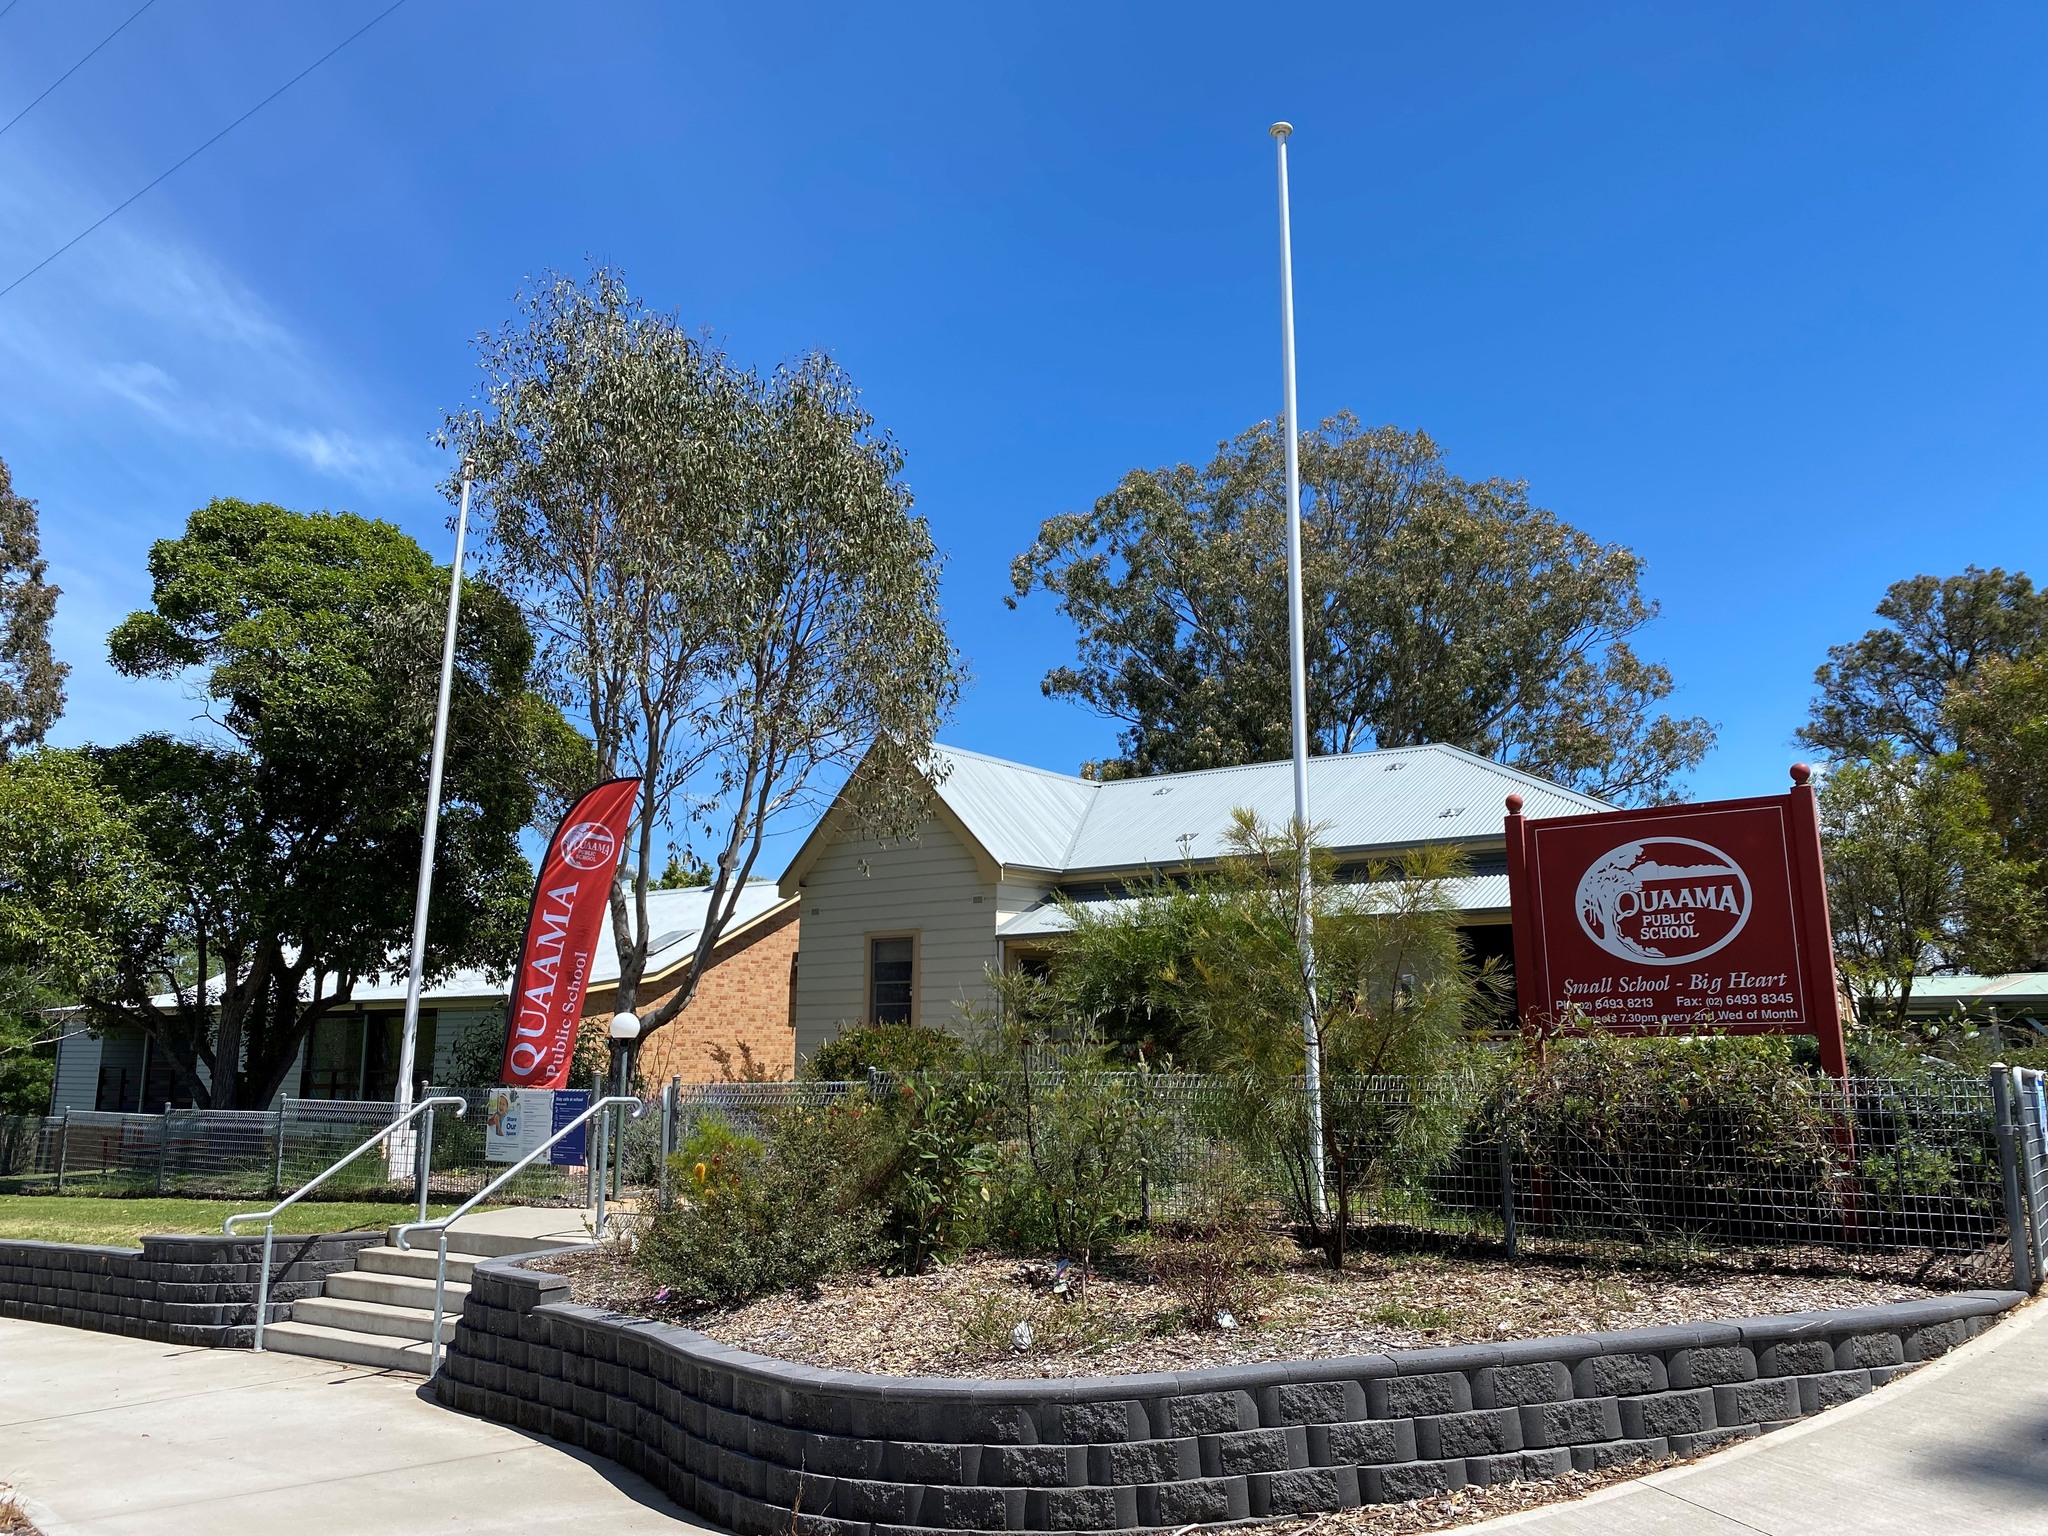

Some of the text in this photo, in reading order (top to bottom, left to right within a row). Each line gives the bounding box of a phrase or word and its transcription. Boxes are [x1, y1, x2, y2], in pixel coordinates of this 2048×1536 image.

[1614, 885, 1741, 922] QUAAMA
[1642, 912, 1695, 927] PUBLIC
[1640, 925, 1700, 940] SCHOOL
[510, 881, 580, 1077] QUAAMA
[1563, 977, 1613, 997] Small
[1618, 974, 1671, 993] School
[1688, 972, 1723, 995] Big
[1728, 971, 1788, 989] Heart
[1595, 998, 1624, 1009] 6493
[1627, 997, 1654, 1008] 8213
[1676, 995, 1702, 1007] Fax:
[1706, 997, 1723, 1007] (02)
[1726, 994, 1758, 1005] 6493
[1761, 993, 1794, 1004] 8345
[546, 1018, 572, 1077] Public
[562, 951, 588, 1013] School
[1620, 1013, 1658, 1025] 7.30pm
[1661, 1013, 1691, 1024] every
[1694, 1011, 1715, 1021] 2nd
[1718, 1009, 1743, 1020] Wed
[1746, 1009, 1758, 1019] of
[1761, 1008, 1798, 1019] Month
[506, 1122, 517, 1130] Our
